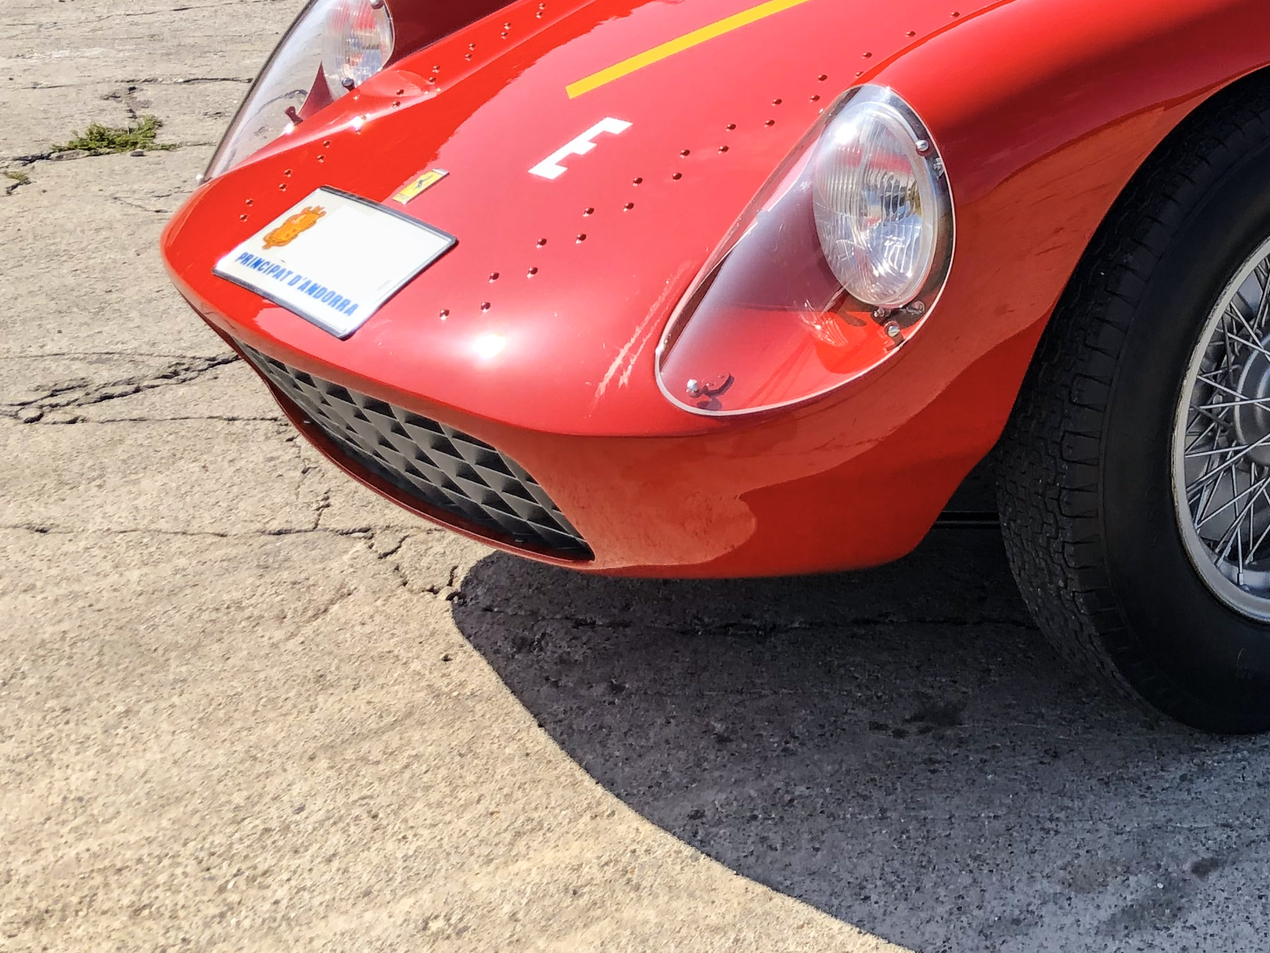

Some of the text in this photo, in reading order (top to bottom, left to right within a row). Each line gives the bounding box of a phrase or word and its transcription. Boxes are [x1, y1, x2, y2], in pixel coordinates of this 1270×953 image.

[528, 116, 634, 180] E
[235, 252, 359, 317] PRINCIPAT D'ANDORRA
